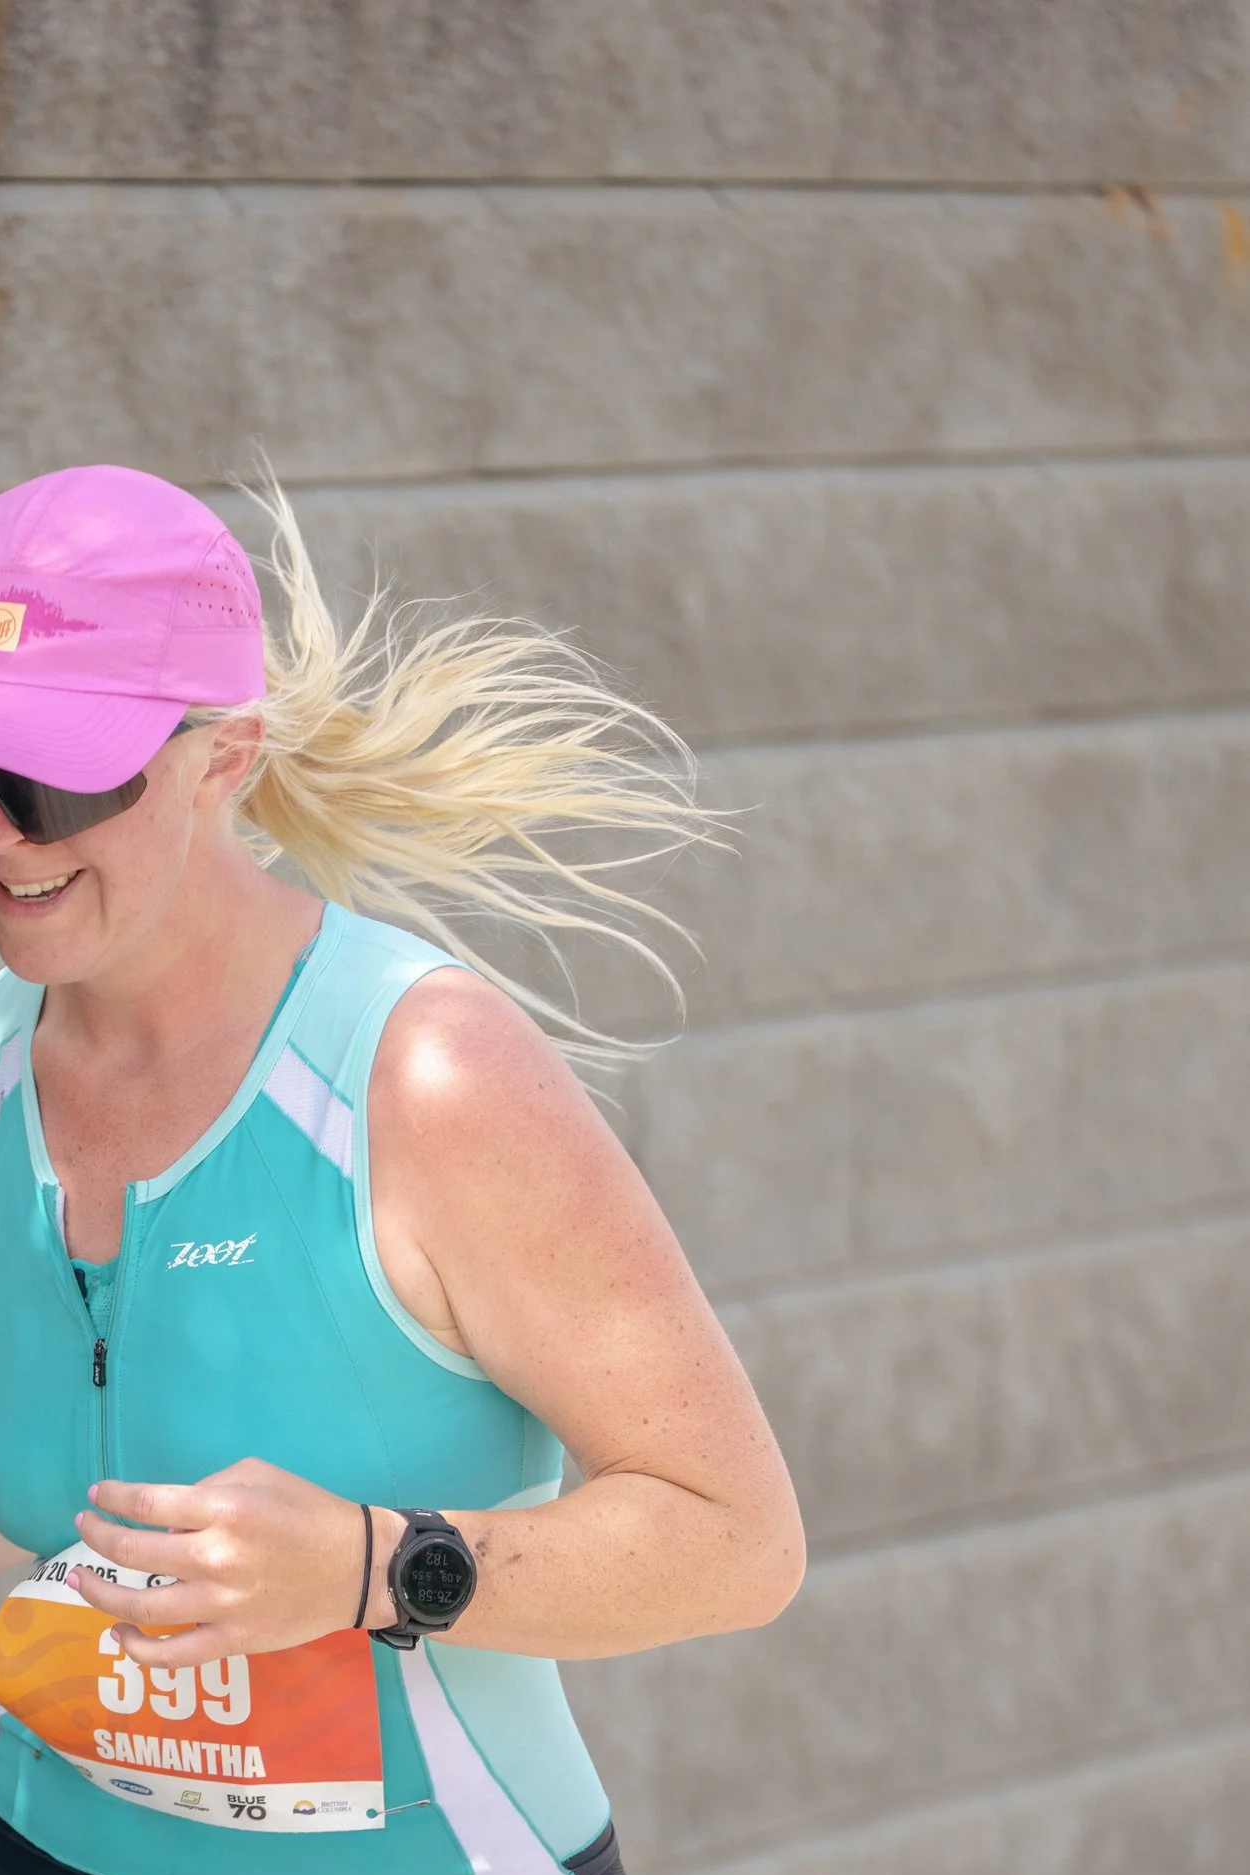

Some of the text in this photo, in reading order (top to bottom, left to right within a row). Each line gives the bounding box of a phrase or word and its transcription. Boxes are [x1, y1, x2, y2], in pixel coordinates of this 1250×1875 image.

[426, 1552, 448, 1566] 182
[418, 1589, 453, 1603] 26:58
[97, 1627, 251, 1726] 399
[93, 1728, 267, 1779] SAMANTHA
[227, 1794, 266, 1805] BLUE
[229, 1803, 267, 1821] 70
